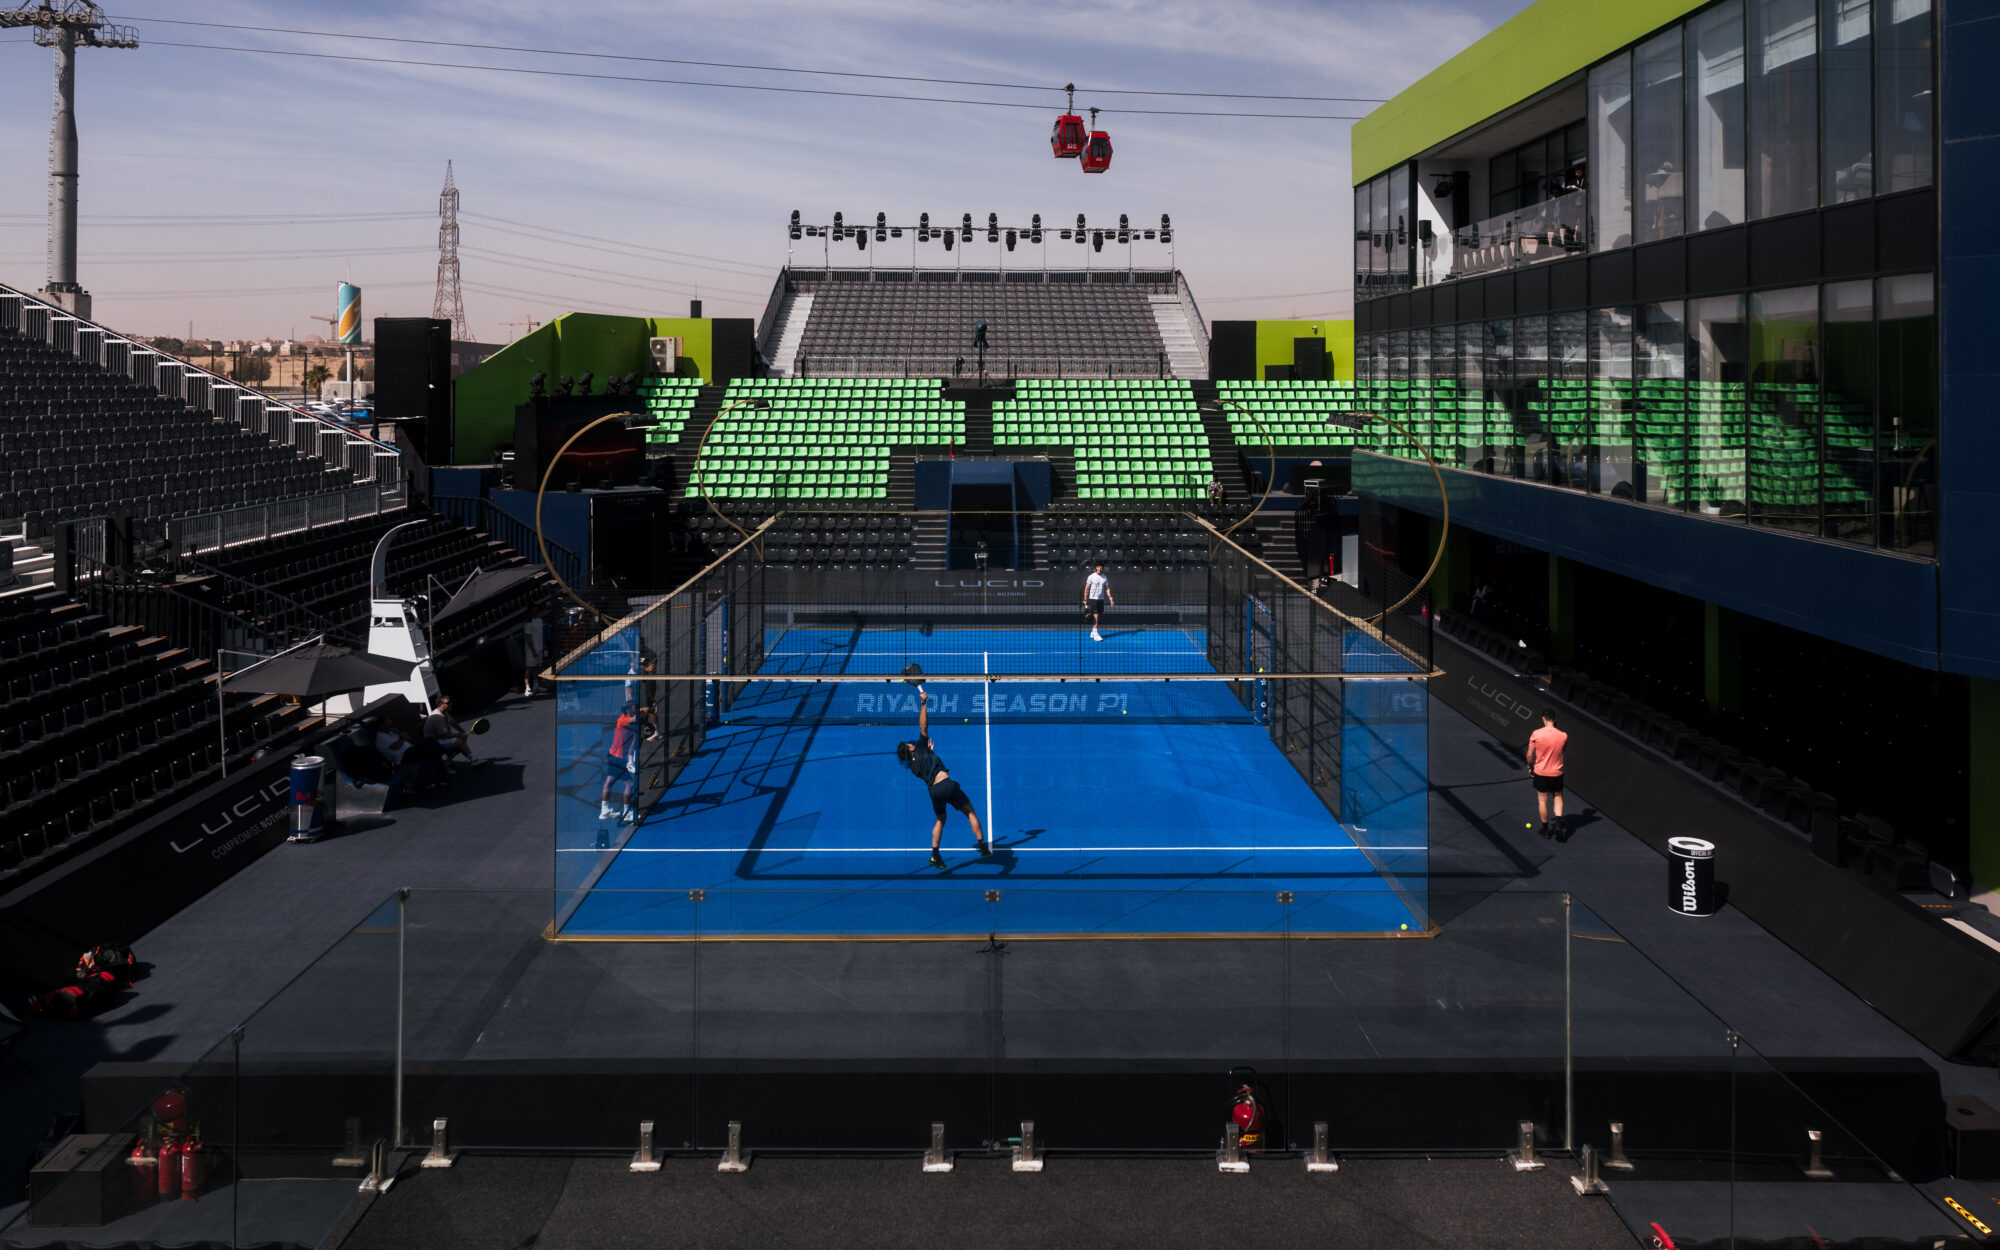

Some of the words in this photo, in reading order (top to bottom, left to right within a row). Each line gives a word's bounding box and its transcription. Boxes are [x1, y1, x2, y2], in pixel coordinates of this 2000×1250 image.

[934, 579, 1045, 588] LUCID
[857, 693, 959, 713] RIYADH
[971, 693, 1088, 713] SEASON
[1096, 693, 1128, 712] P1
[1466, 675, 1533, 720] LUCID
[169, 776, 291, 854] LUCID
[211, 824, 263, 859] COMPROMISE
[1682, 860, 1697, 912] Wilson
